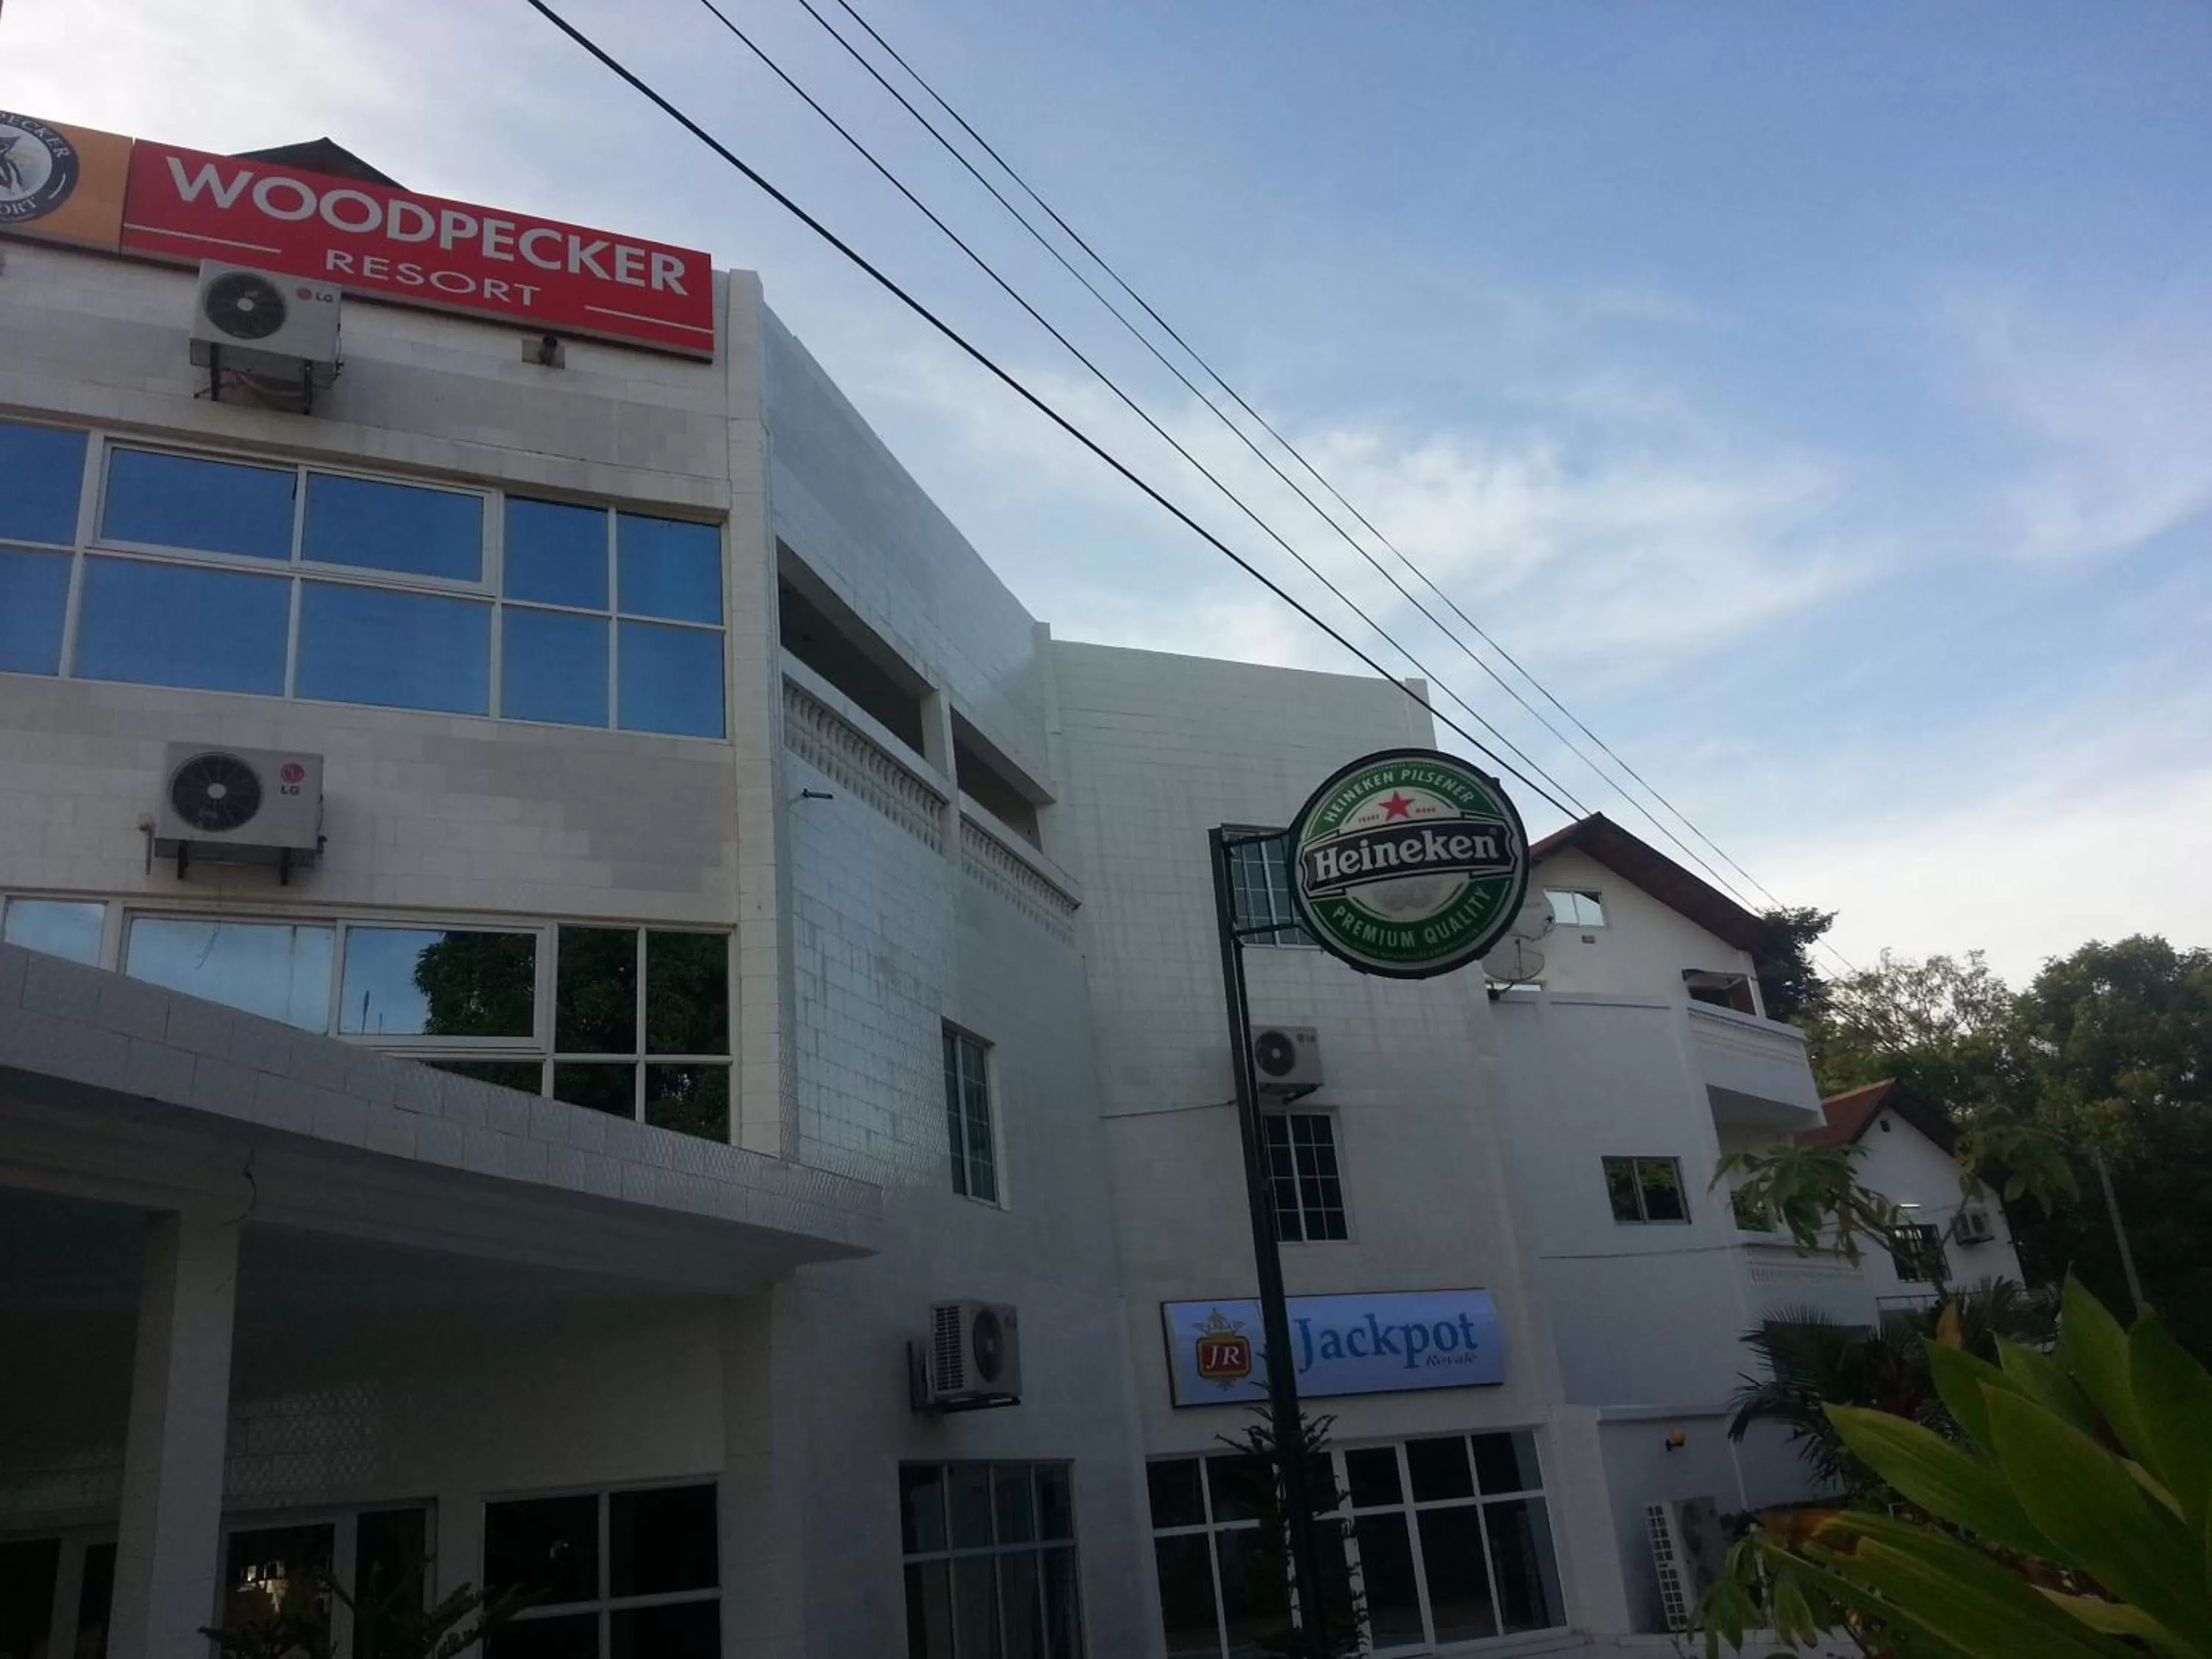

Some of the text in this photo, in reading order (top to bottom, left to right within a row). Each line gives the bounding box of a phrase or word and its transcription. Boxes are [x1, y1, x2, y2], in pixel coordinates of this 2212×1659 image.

[166, 156, 689, 296] WOODPECKER
[316, 293, 333, 303] LG
[325, 249, 541, 307] RESORT
[281, 785, 300, 795] LG
[1324, 769, 1475, 822] HEINEKEN PILSENER
[1314, 830, 1498, 882] Heineken
[1333, 905, 1416, 947] PREMIUM
[1423, 886, 1491, 944] QUALITY
[1206, 1346, 1240, 1369] JR
[1293, 1312, 1478, 1374] Jackpot
